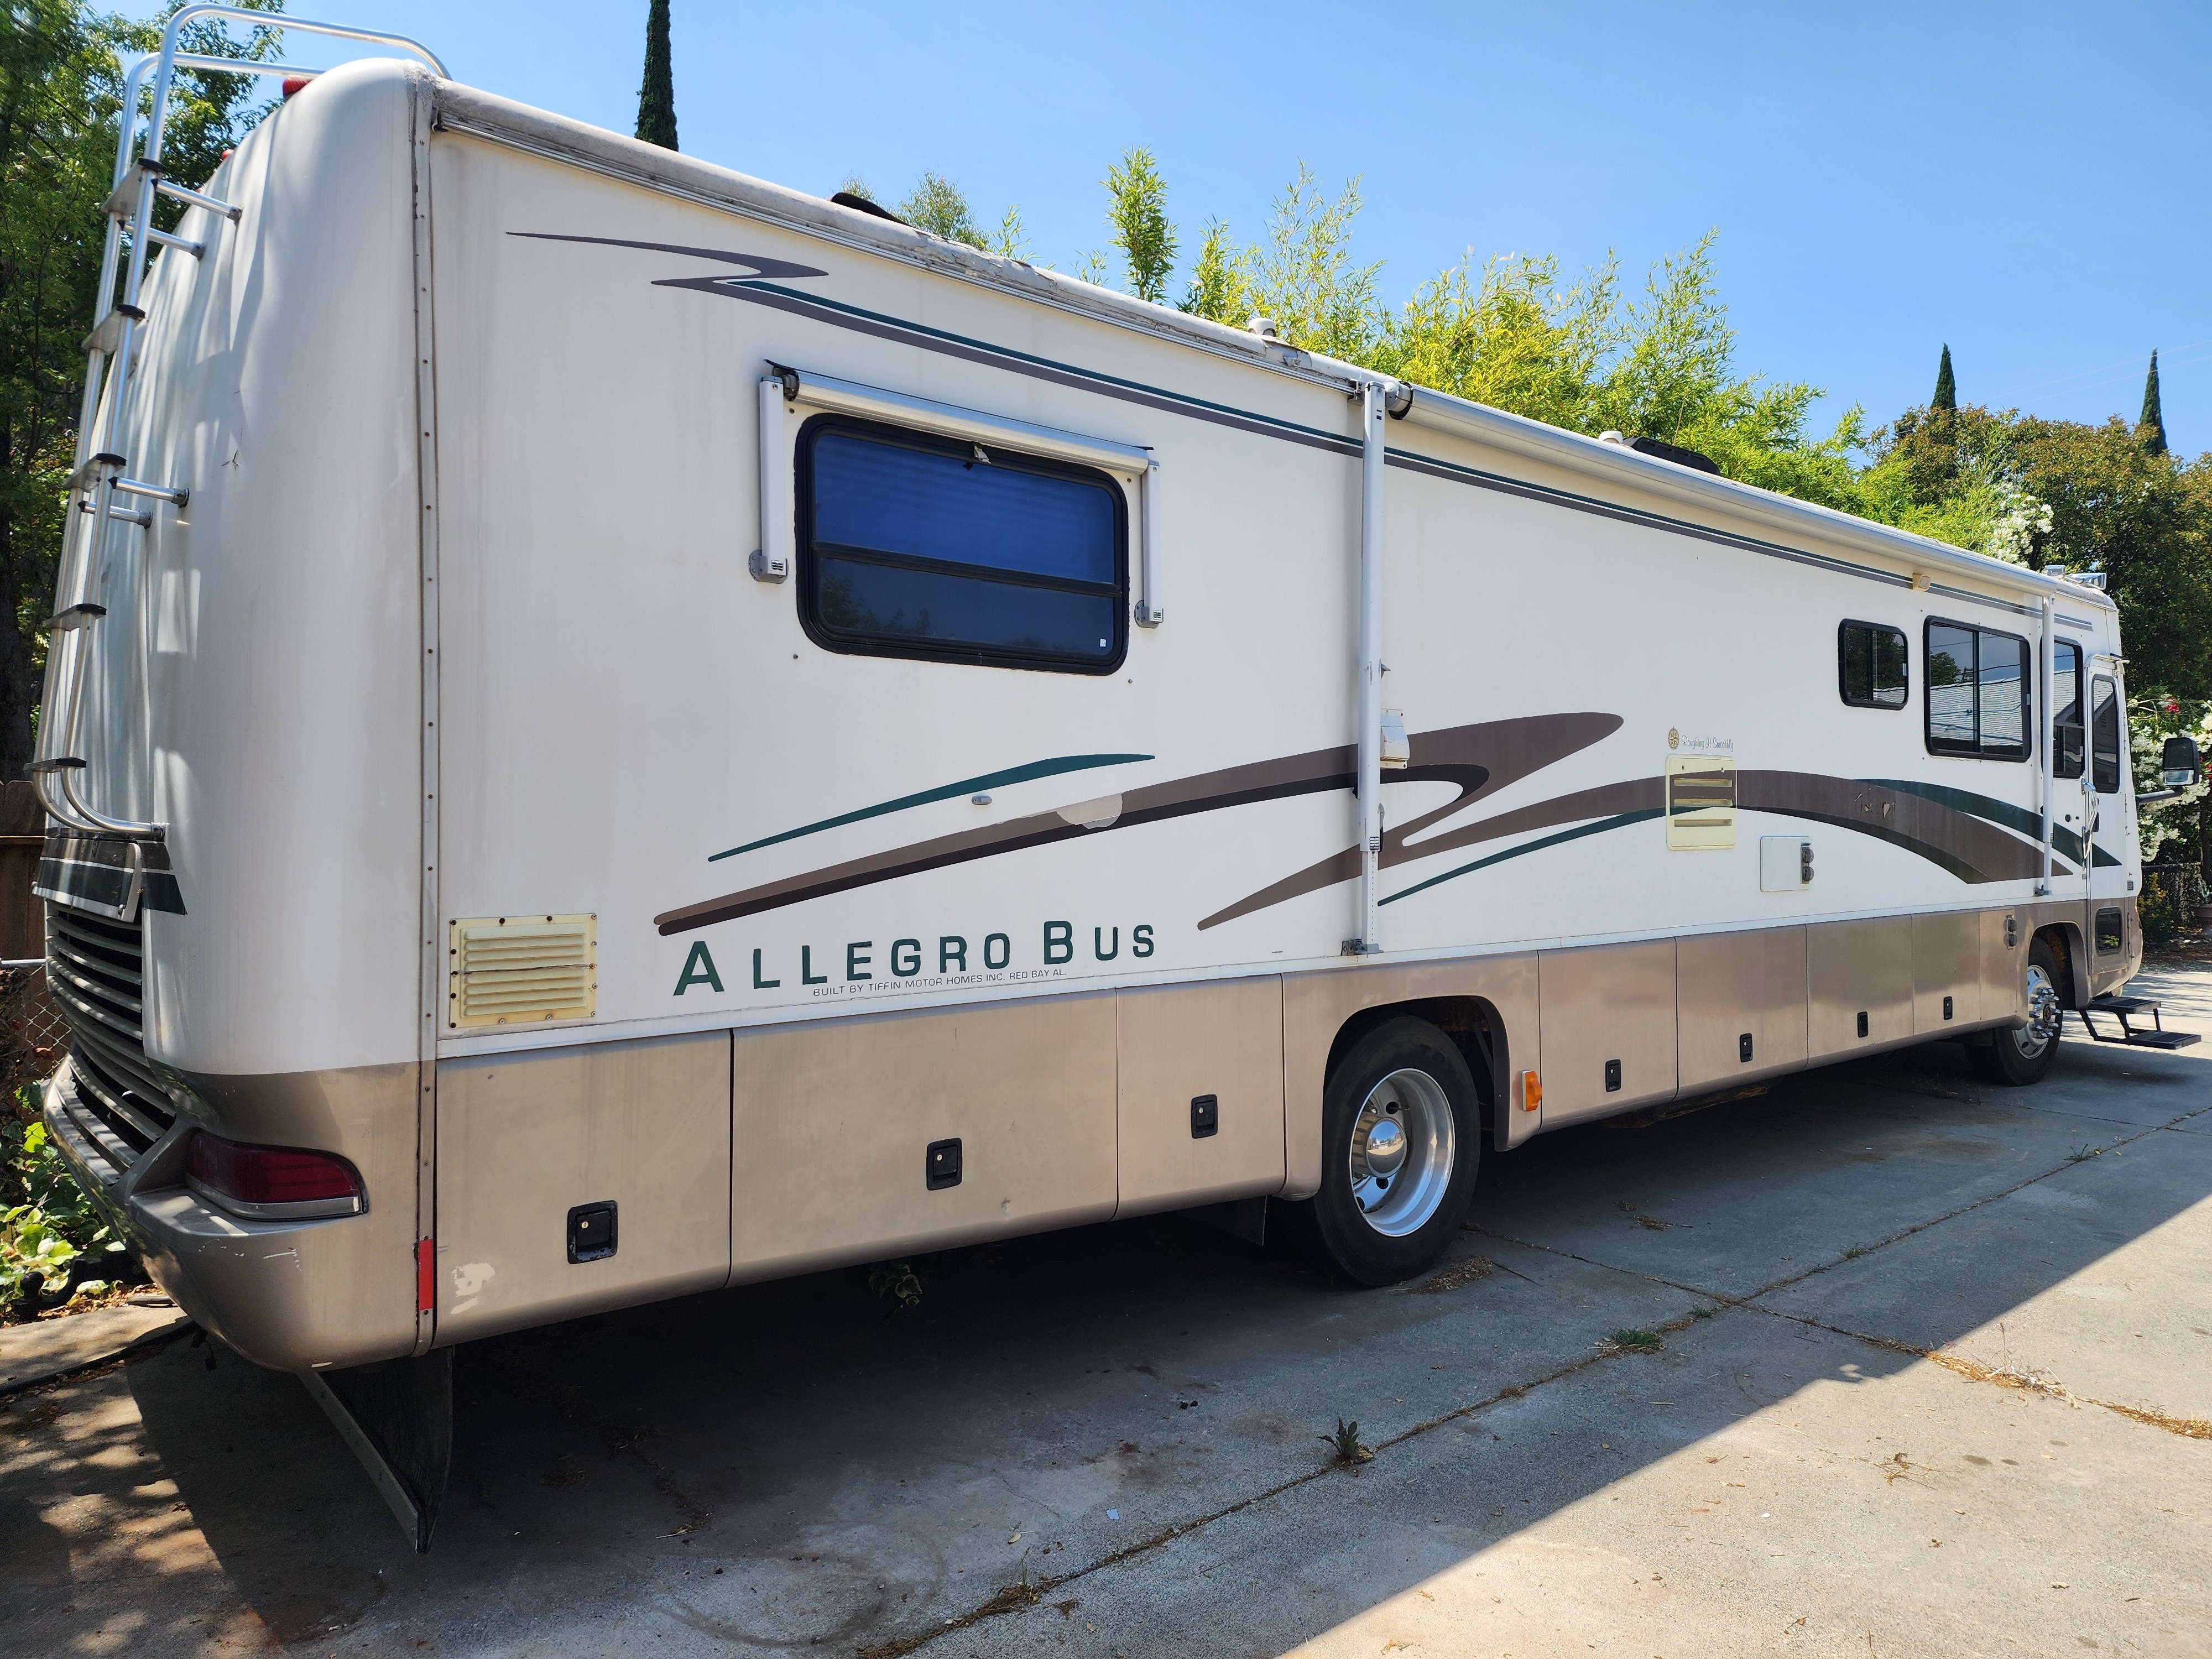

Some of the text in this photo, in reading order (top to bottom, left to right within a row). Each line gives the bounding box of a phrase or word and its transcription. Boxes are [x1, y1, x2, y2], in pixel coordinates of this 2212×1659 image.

[1681, 735, 1734, 752] Roughing It Smoothly
[813, 968, 1067, 997] BUILT BY TIFFIN MOTOR HOMES INC. RED BAY AL.
